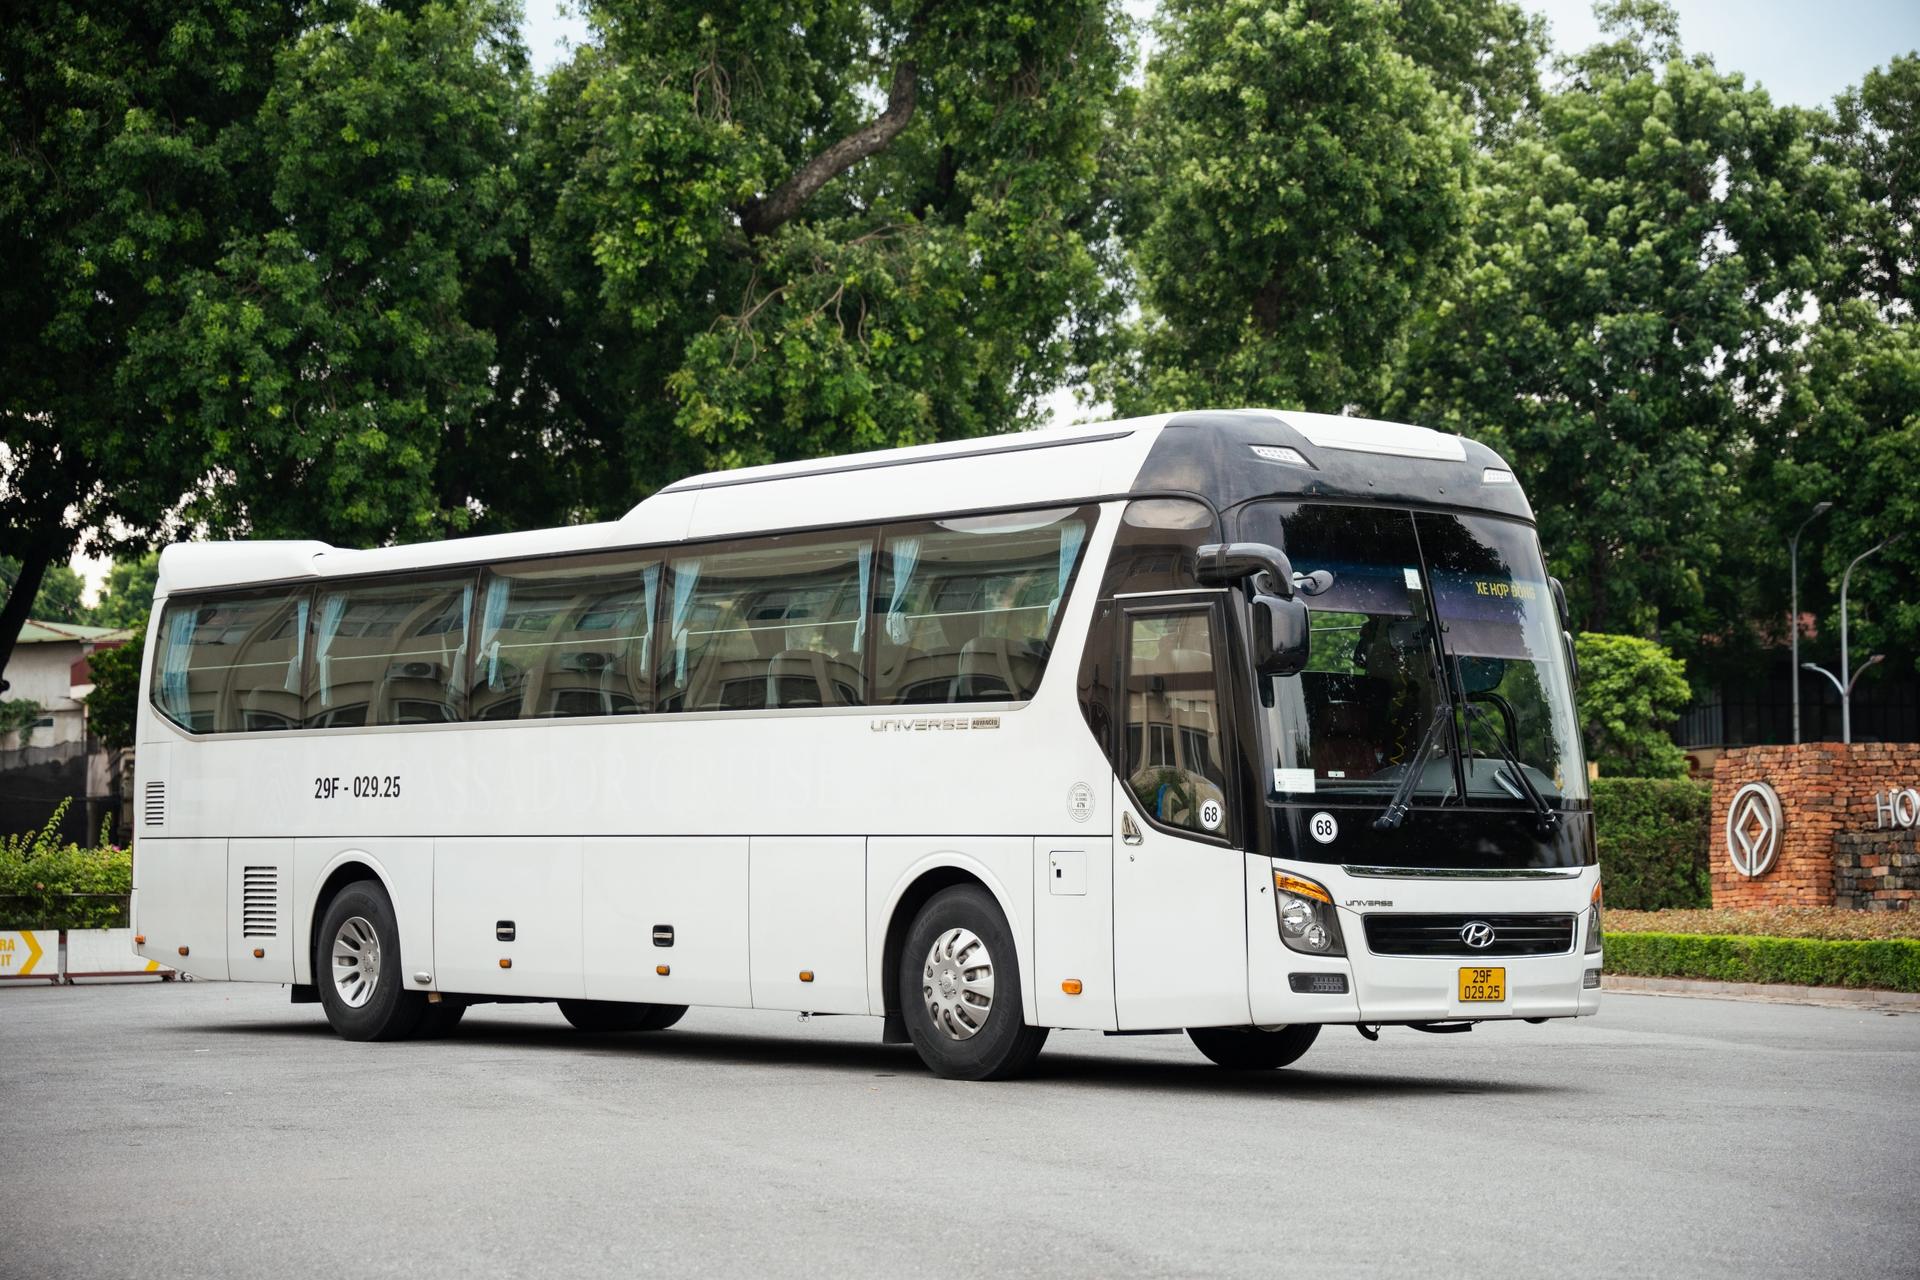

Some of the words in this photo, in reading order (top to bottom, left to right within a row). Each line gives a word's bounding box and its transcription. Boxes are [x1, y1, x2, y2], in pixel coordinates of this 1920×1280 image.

[1475, 581, 1489, 595] XE
[871, 719, 969, 732] UNIVERSE
[315, 777, 339, 798] 29F
[353, 776, 400, 798] 029.25
[1204, 806, 1218, 822] 68
[1875, 789, 1920, 829] HO
[1316, 819, 1333, 836] 68
[1345, 899, 1393, 907] UNIVERSE
[0, 954, 12, 967] IT
[1472, 969, 1492, 984] 29F
[1464, 985, 1500, 999] 029.25
